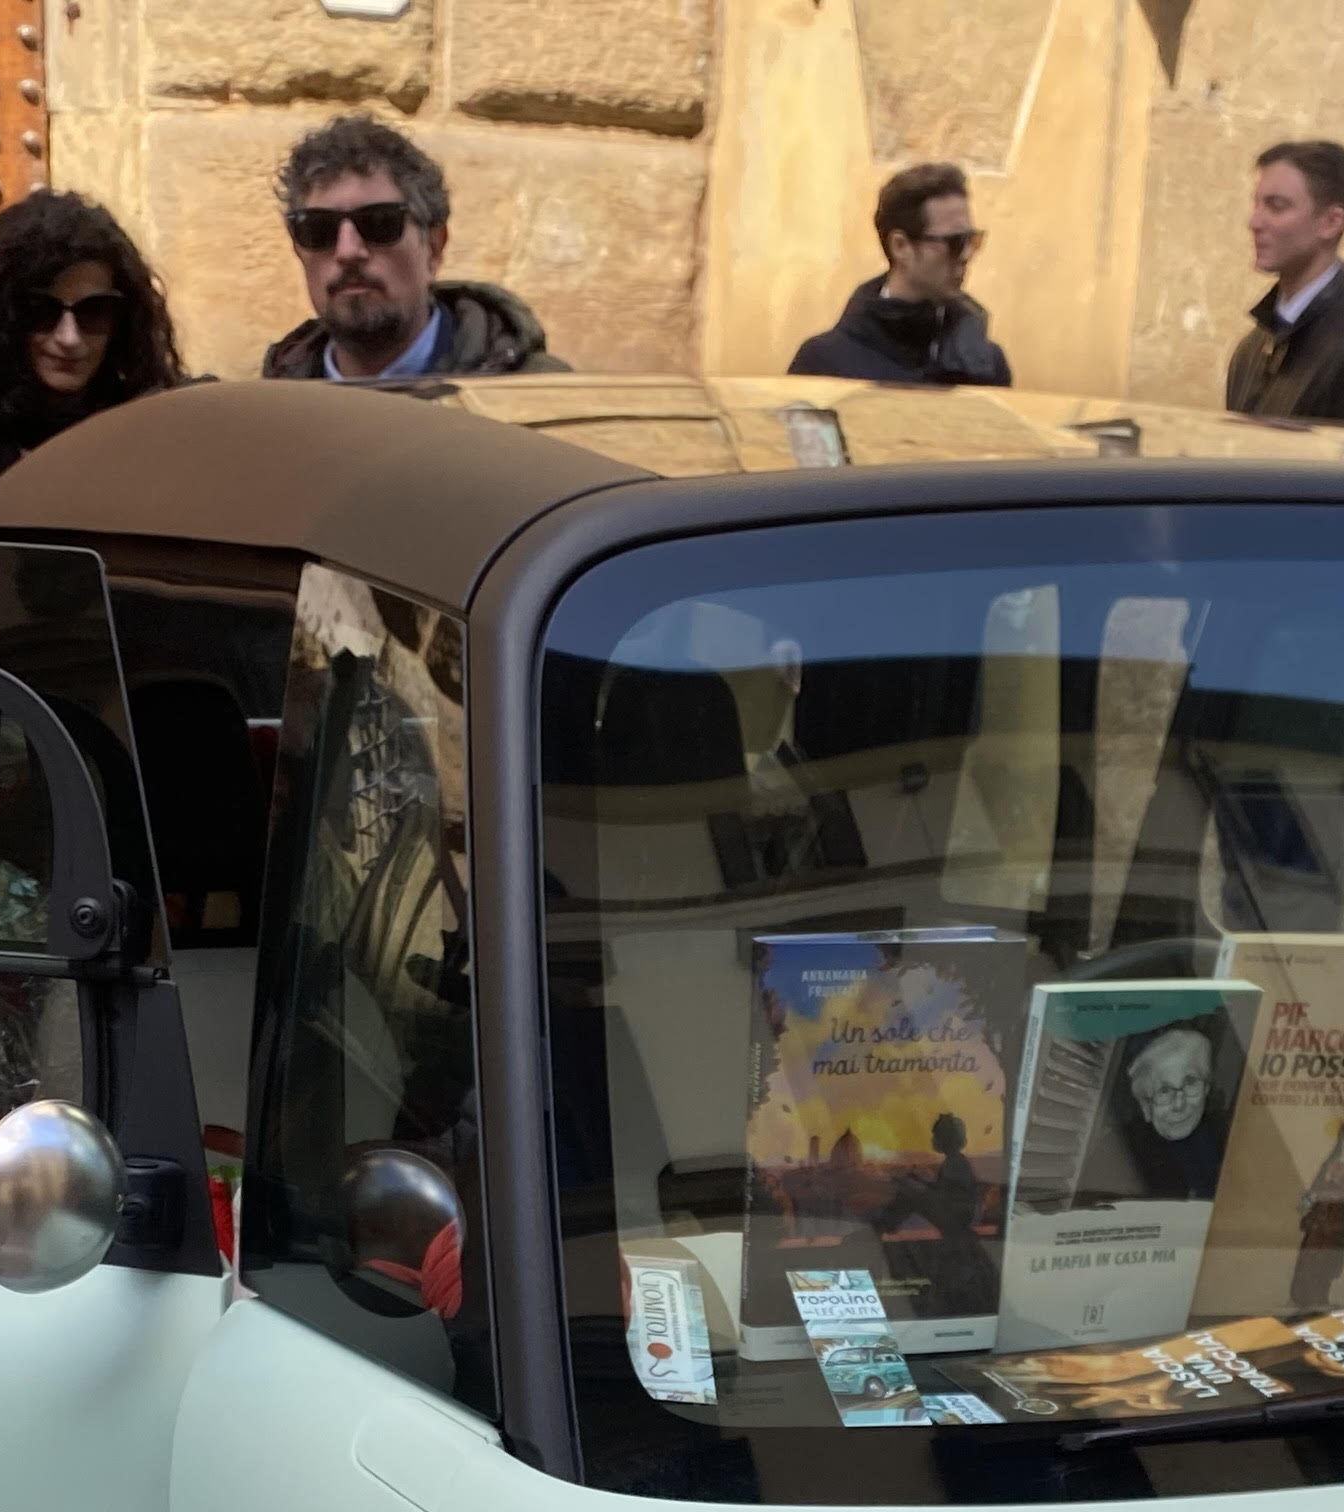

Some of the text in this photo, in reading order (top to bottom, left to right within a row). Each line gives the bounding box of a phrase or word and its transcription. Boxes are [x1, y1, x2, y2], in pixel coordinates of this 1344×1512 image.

[1272, 1001, 1310, 1026] PIF
[830, 1017, 970, 1045] Un sole che
[812, 1052, 981, 1076] mai tramonta
[1258, 1054, 1287, 1078] IO
[1031, 1249, 1177, 1273] LA MAFIA IN CASA MIA
[1141, 1344, 1220, 1399] LASCIA
[1182, 1351, 1234, 1385] UNA
